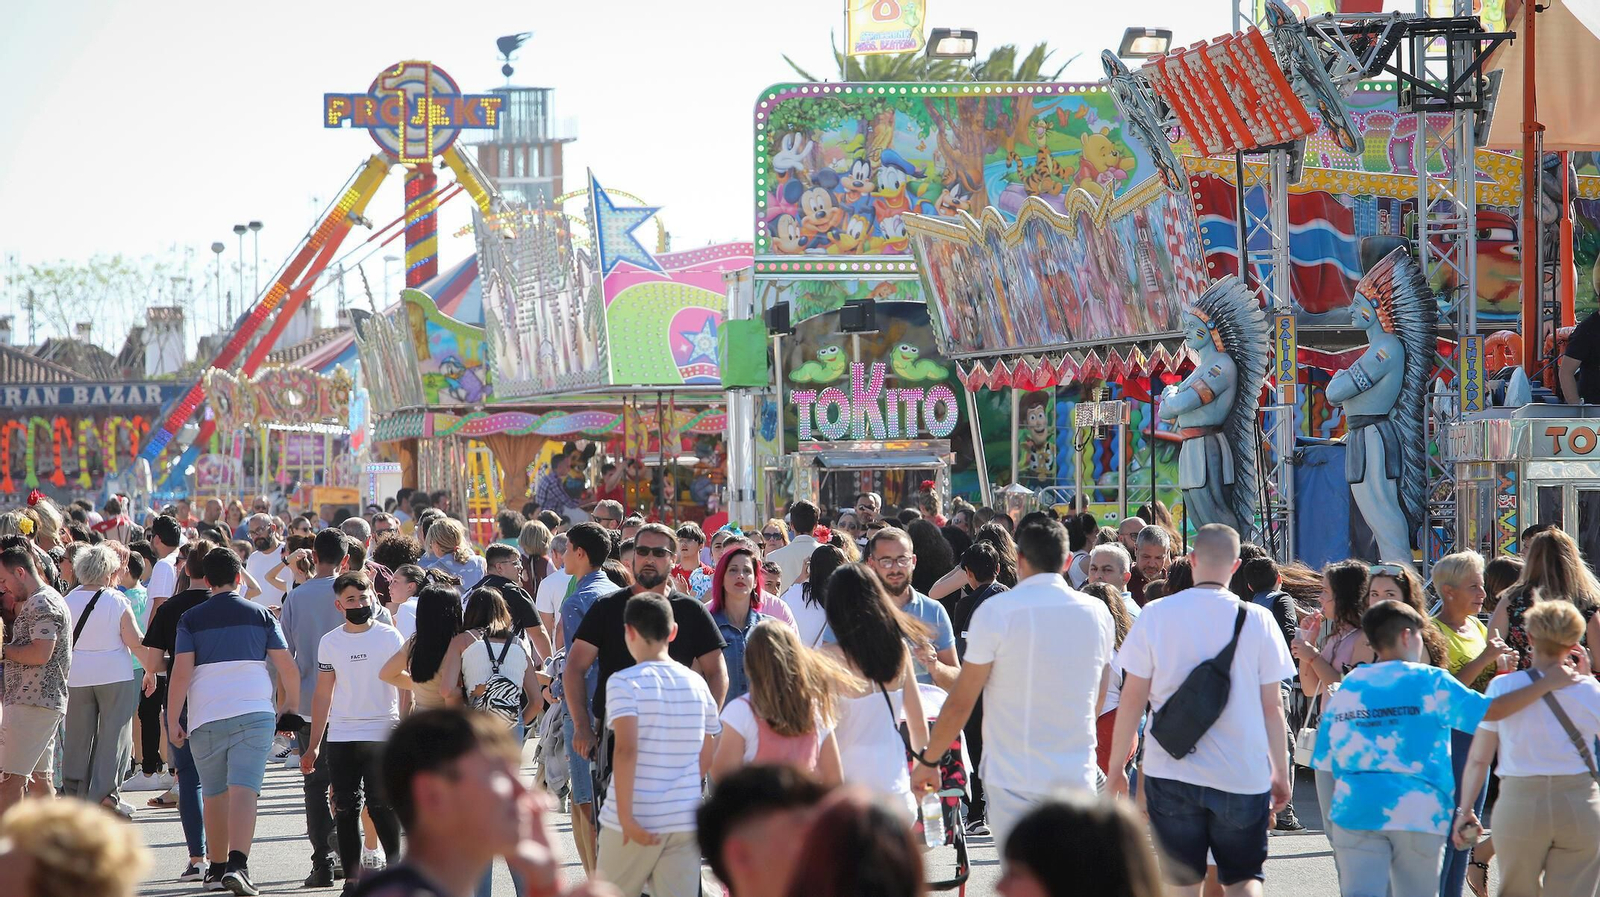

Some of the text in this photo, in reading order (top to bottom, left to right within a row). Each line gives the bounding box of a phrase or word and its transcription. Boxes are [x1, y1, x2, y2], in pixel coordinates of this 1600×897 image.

[327, 97, 502, 126] PROJEKT
[1278, 317, 1294, 382] SALIDA
[1464, 337, 1480, 411] ENTRADA
[0, 385, 162, 407] RAN BAZAR
[789, 361, 959, 440] TOKITO
[1545, 426, 1600, 456] TO
[1335, 705, 1420, 722] FEARLESS CONNECTION
